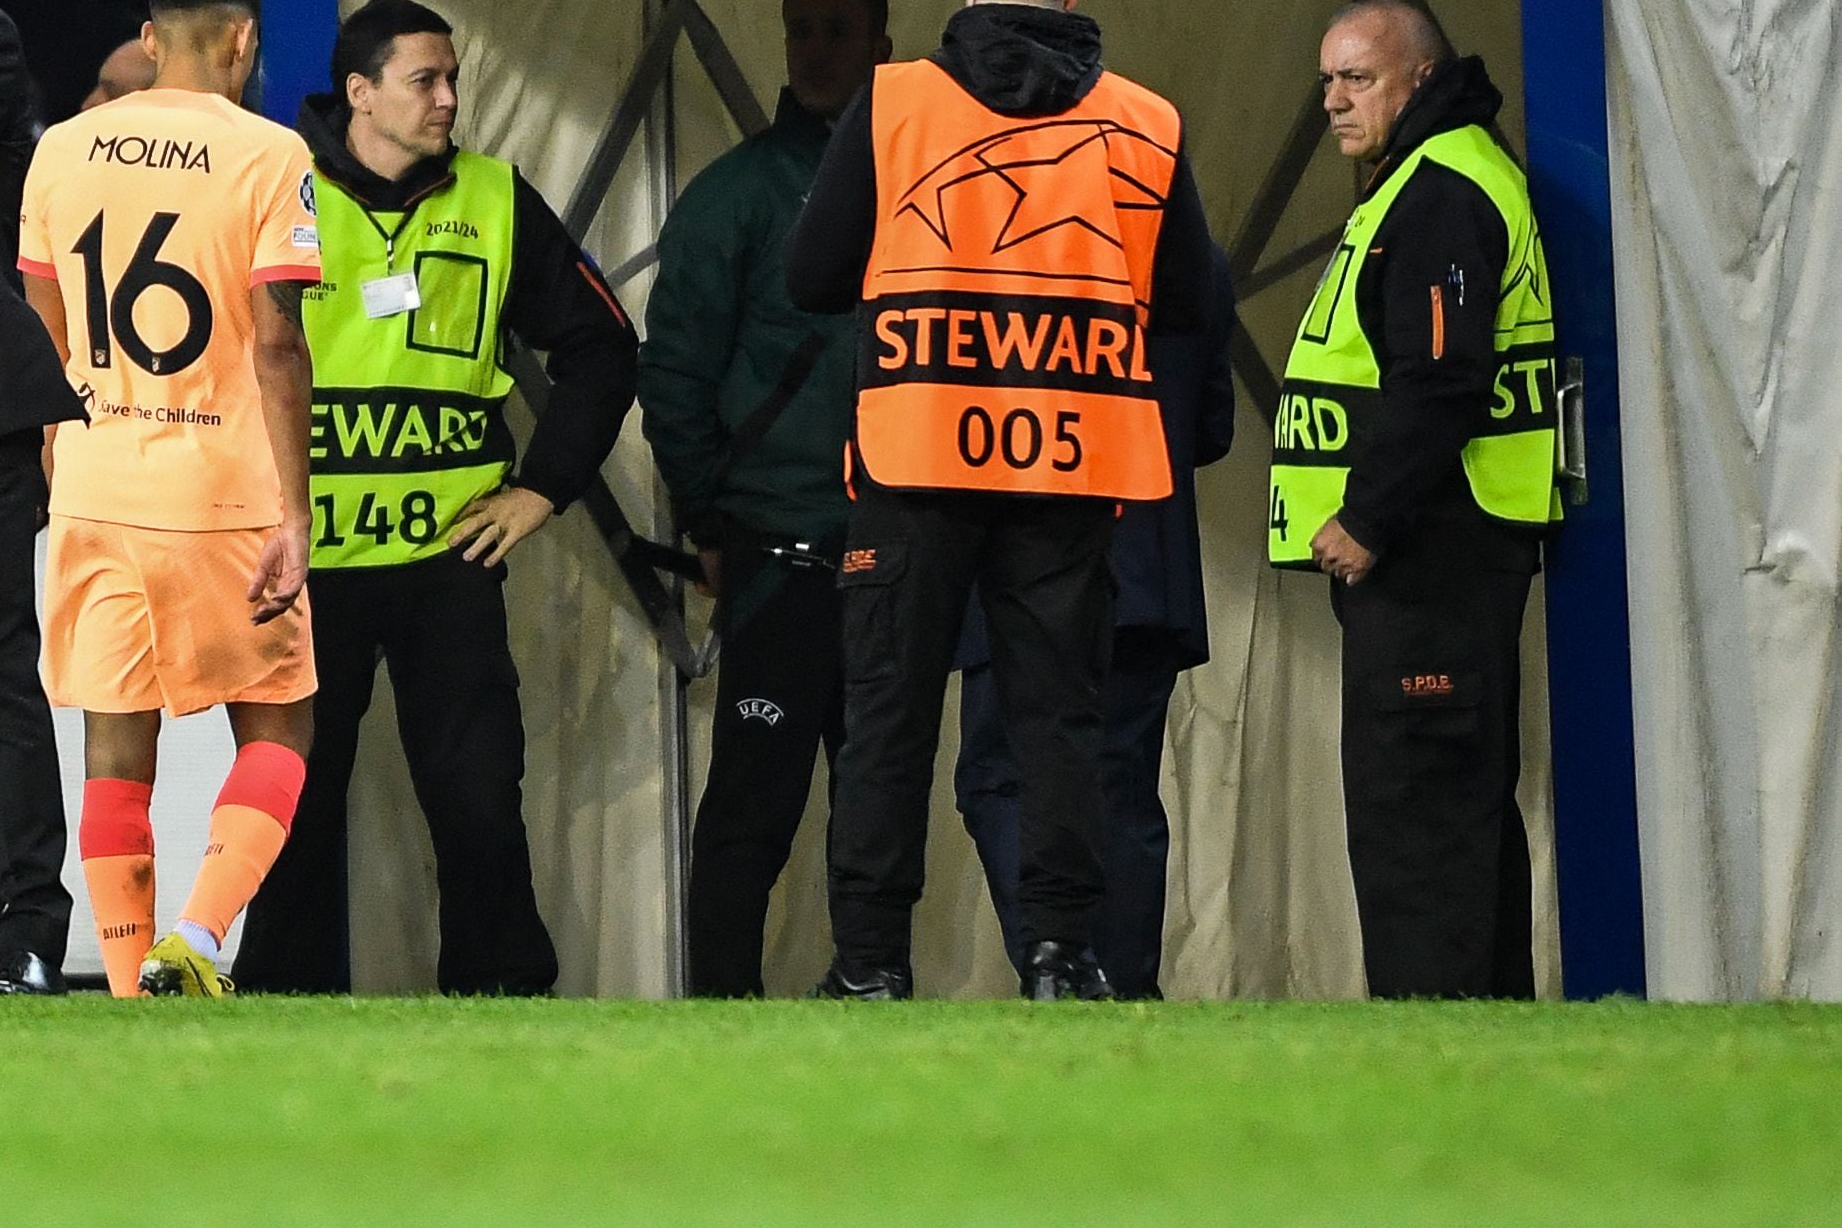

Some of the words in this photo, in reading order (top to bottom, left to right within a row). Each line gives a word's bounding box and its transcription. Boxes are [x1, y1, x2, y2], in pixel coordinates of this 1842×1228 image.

[88, 135, 211, 174] MOLINA
[425, 222, 479, 240] 2021/24
[69, 207, 213, 377] 16
[156, 408, 221, 426] Children
[958, 406, 1082, 472] 005
[315, 490, 437, 548] 148
[738, 701, 780, 724] UEFA
